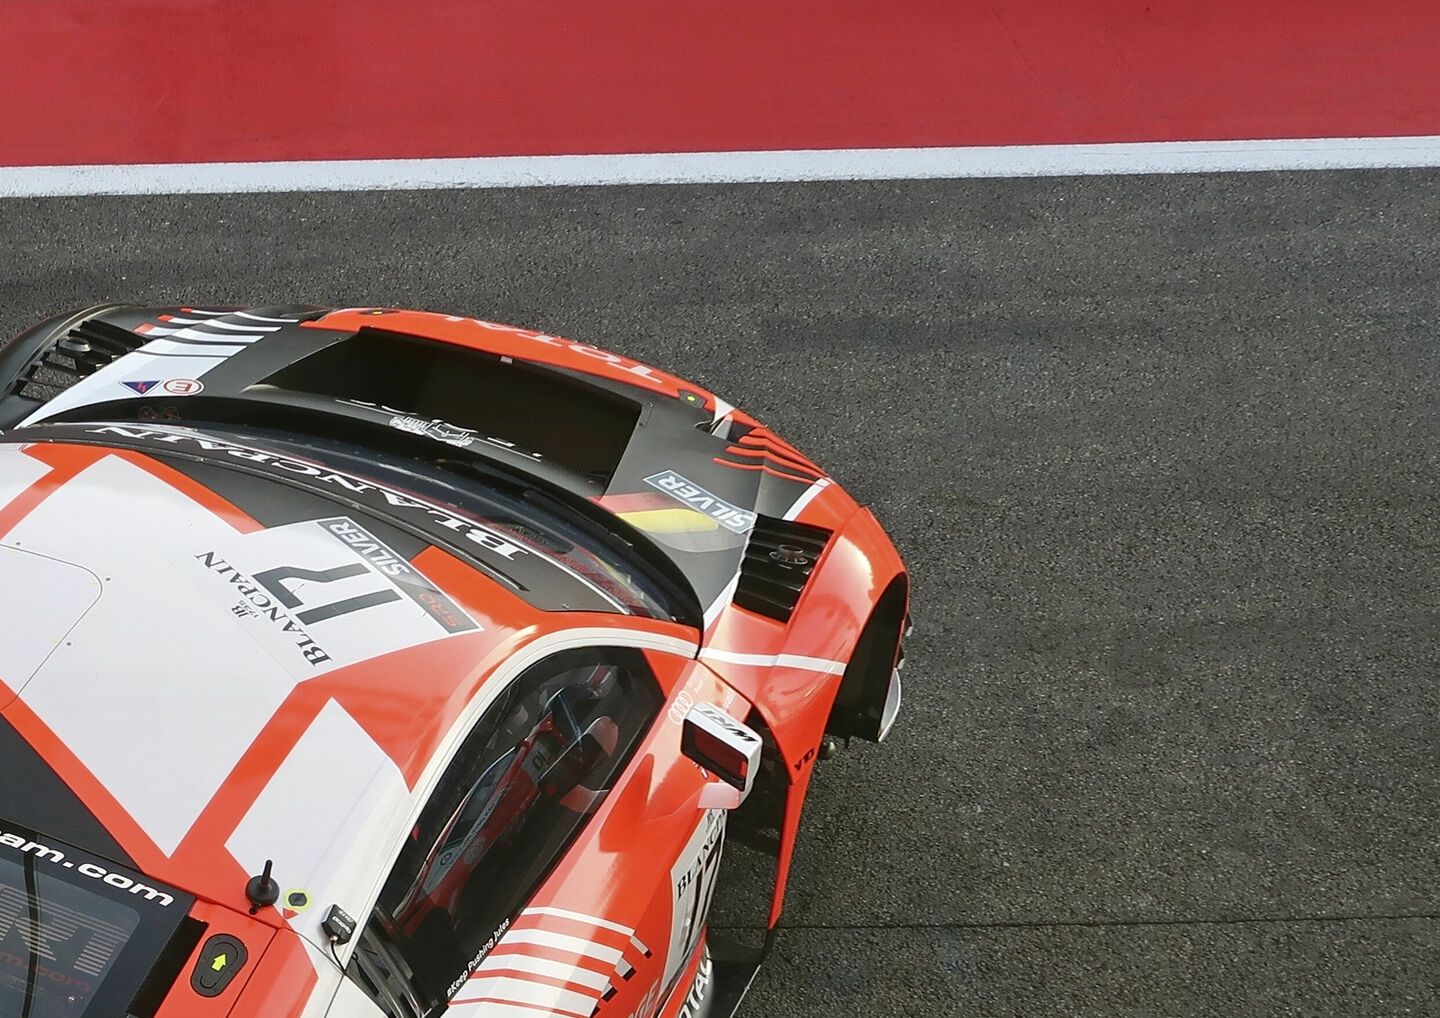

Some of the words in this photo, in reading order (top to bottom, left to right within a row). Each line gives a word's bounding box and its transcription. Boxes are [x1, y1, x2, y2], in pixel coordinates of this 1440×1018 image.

[85, 426, 529, 560] BLANCPAIN
[658, 475, 752, 528] SILVER
[329, 522, 410, 576] SILVER
[194, 551, 333, 667] BLANCPAIN
[251, 562, 403, 626] 17
[468, 938, 493, 971] Pushing
[494, 918, 509, 941] Jules
